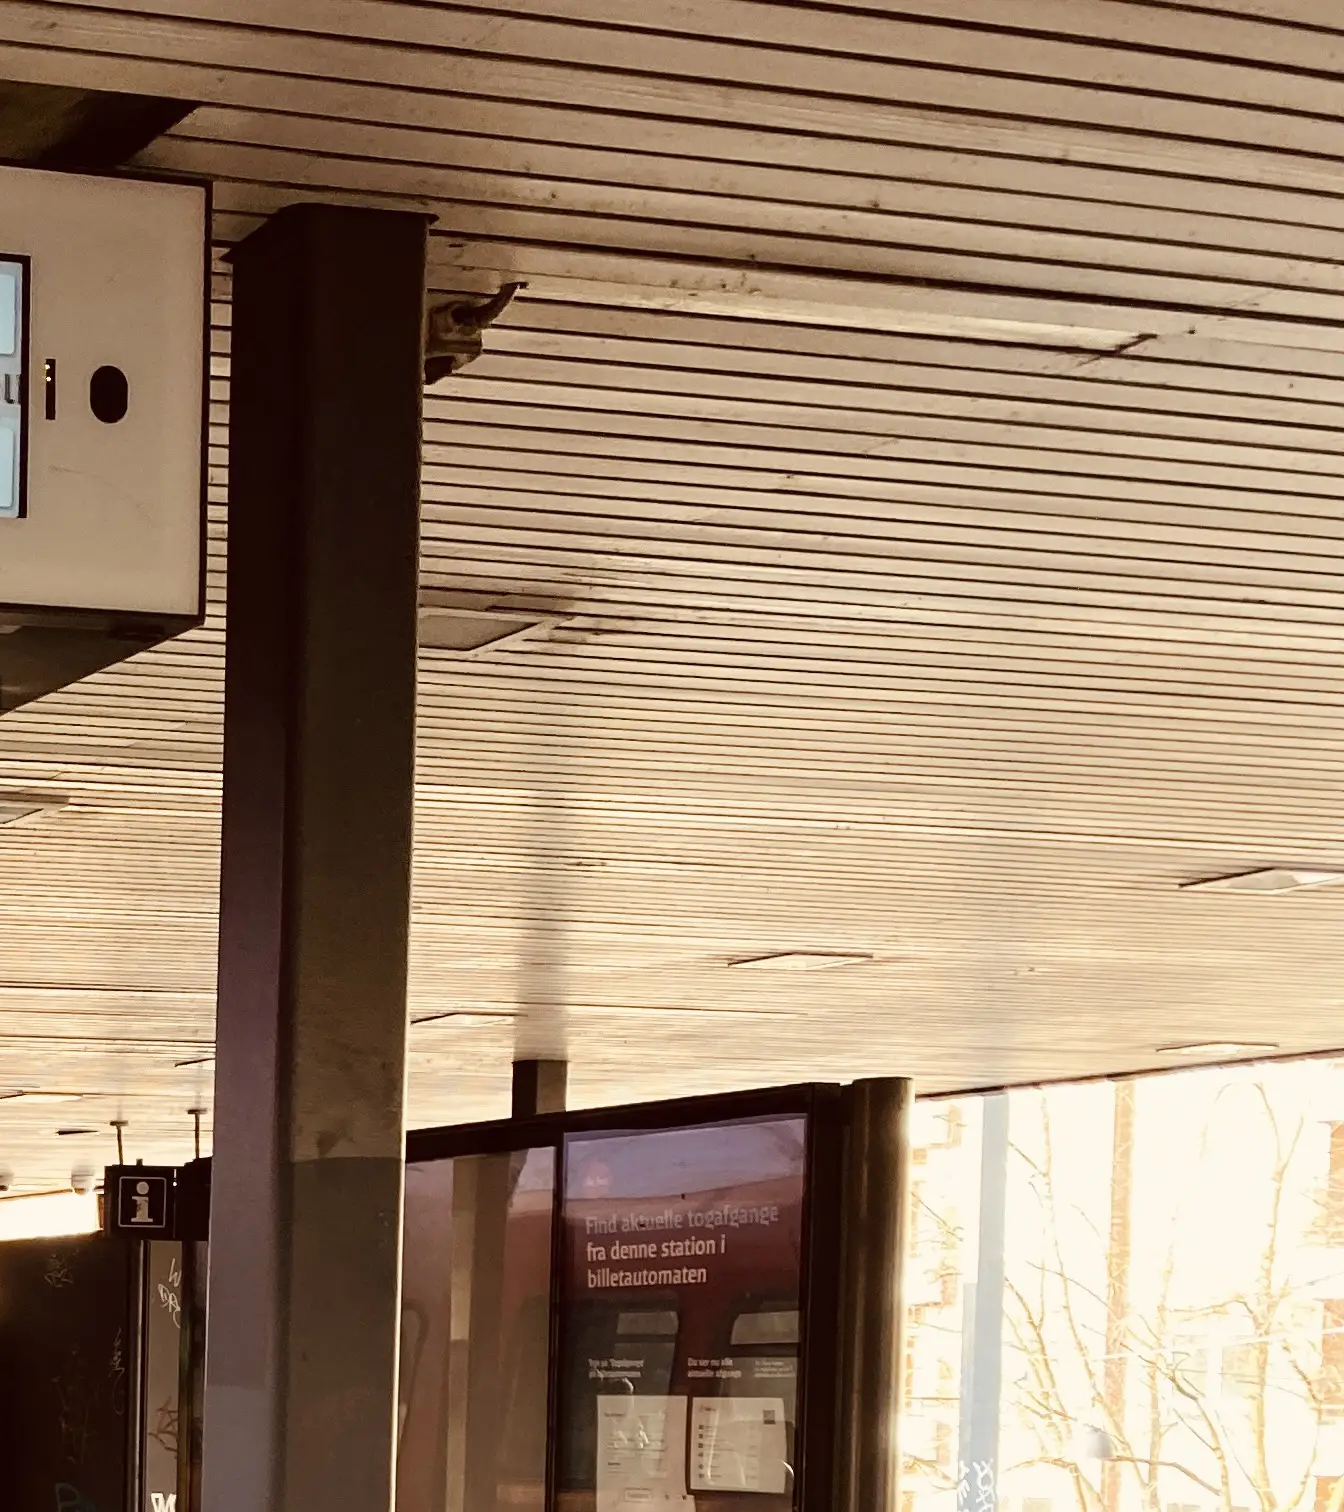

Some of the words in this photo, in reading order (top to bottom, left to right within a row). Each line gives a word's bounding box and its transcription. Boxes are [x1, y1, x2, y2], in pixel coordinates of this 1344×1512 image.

[585, 1216, 617, 1235] Find
[621, 1209, 683, 1232] aktuelle
[687, 1203, 779, 1231] togafgange
[587, 1242, 606, 1262] fra
[611, 1240, 657, 1260] denne
[661, 1236, 716, 1258] station
[720, 1233, 726, 1254] i
[587, 1267, 707, 1288] billetautomaten
